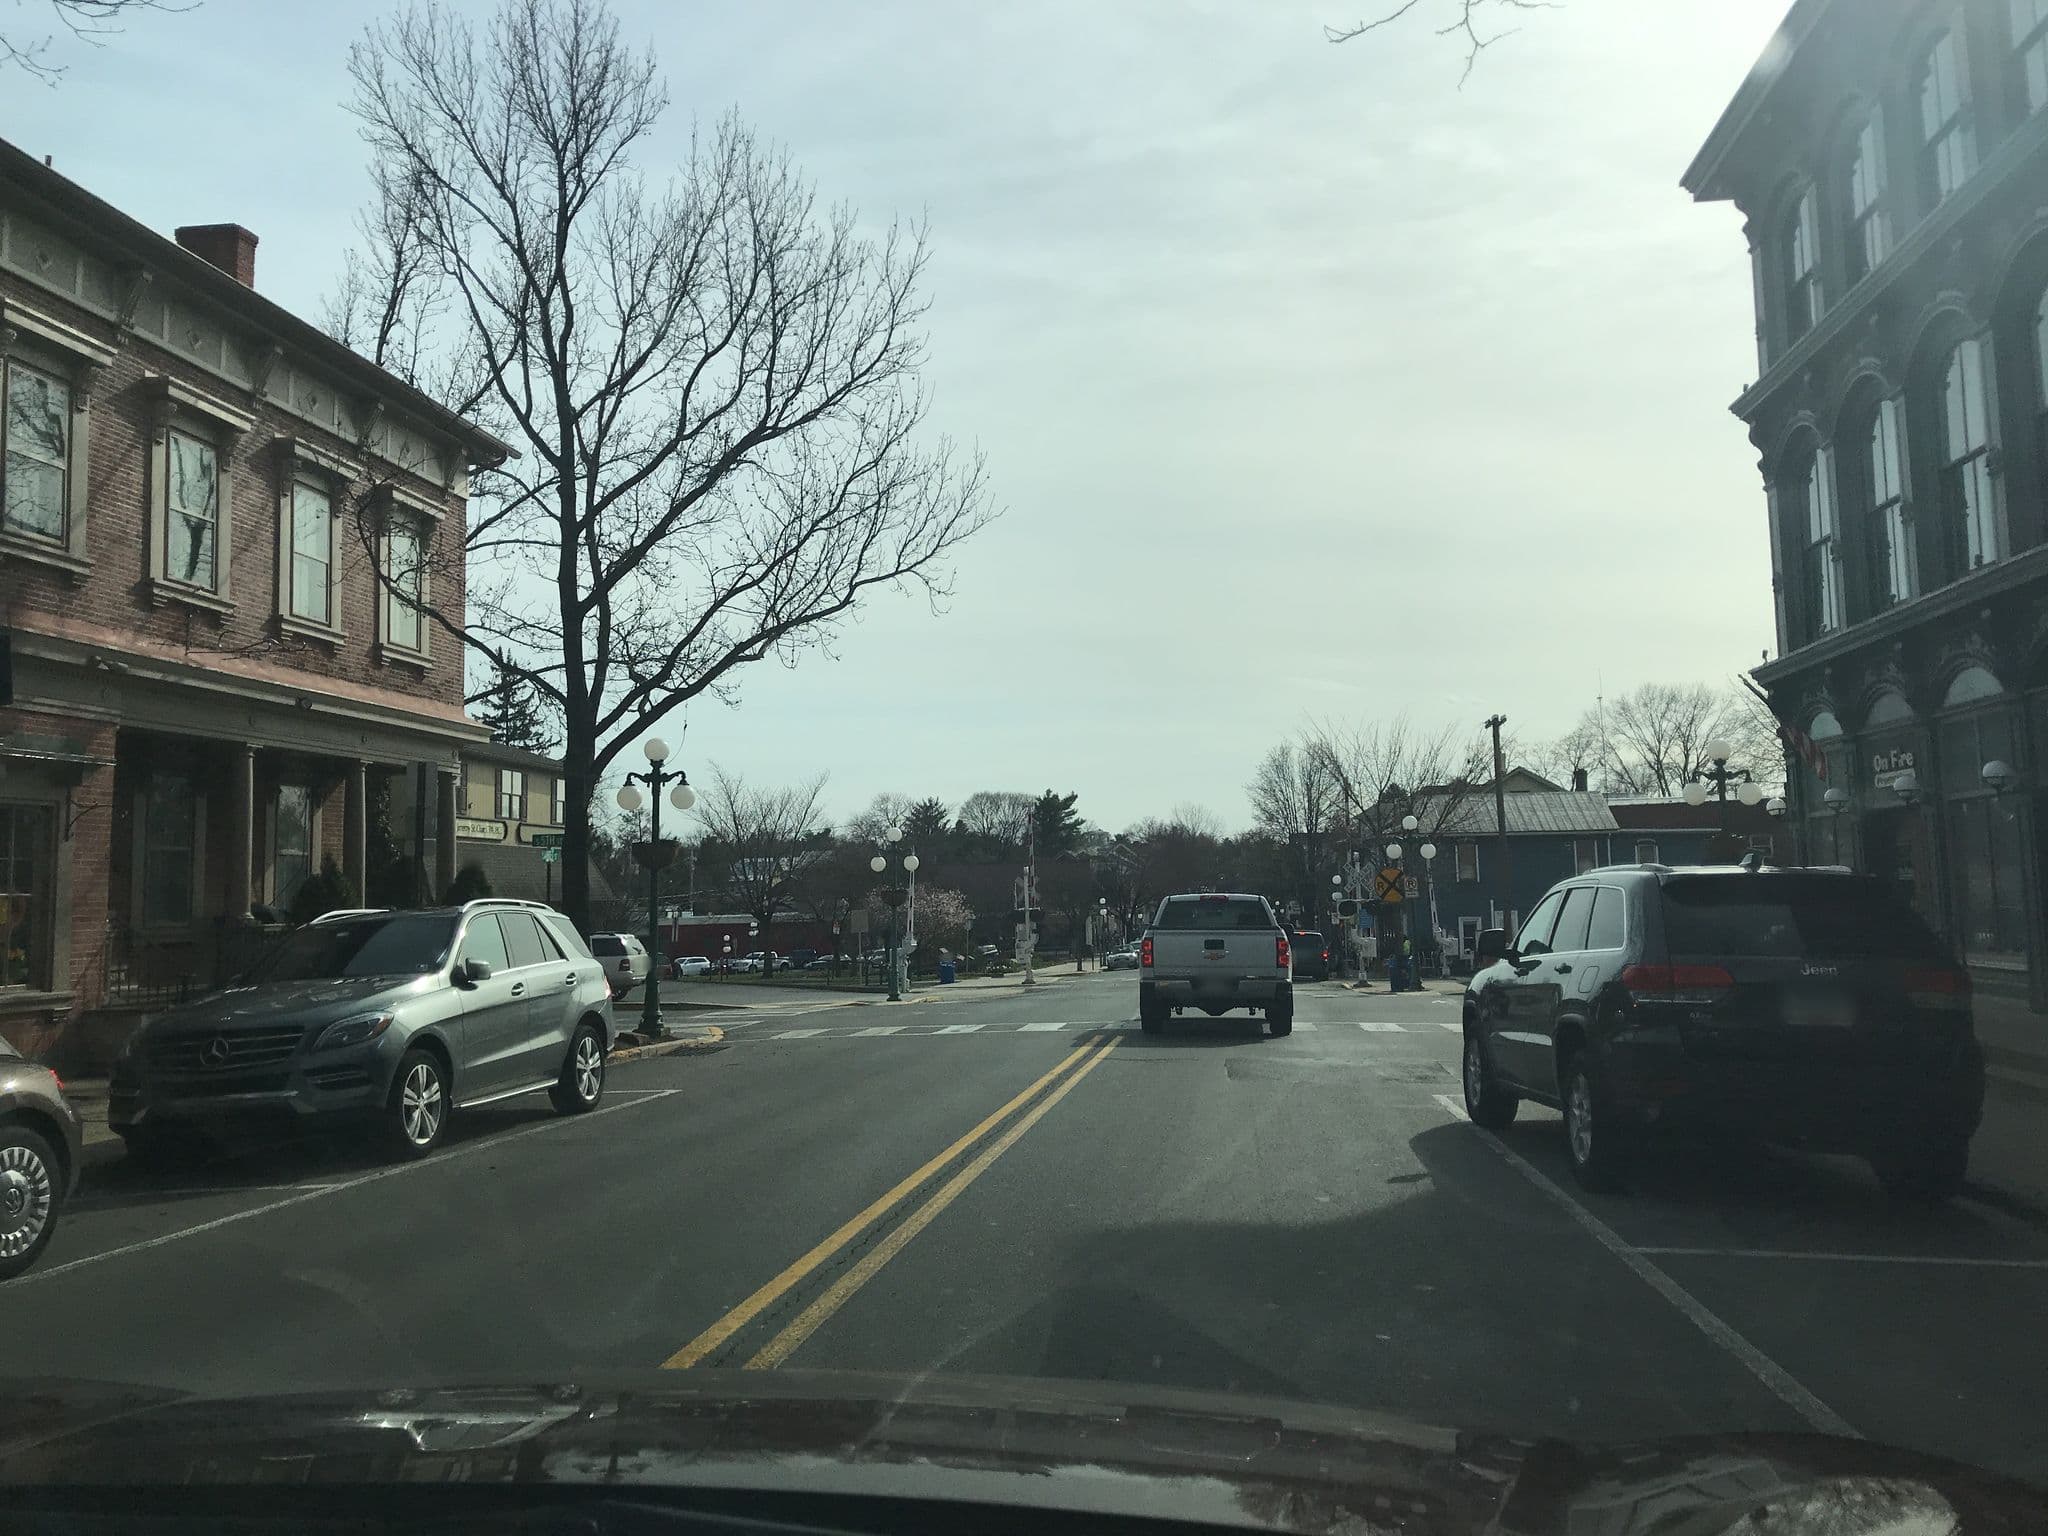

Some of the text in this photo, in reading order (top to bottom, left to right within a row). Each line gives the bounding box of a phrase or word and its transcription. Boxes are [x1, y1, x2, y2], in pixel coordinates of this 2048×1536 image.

[1873, 749, 1913, 772] On Fire
[1377, 882, 1385, 890] R
[1800, 963, 1840, 977] Jeep
